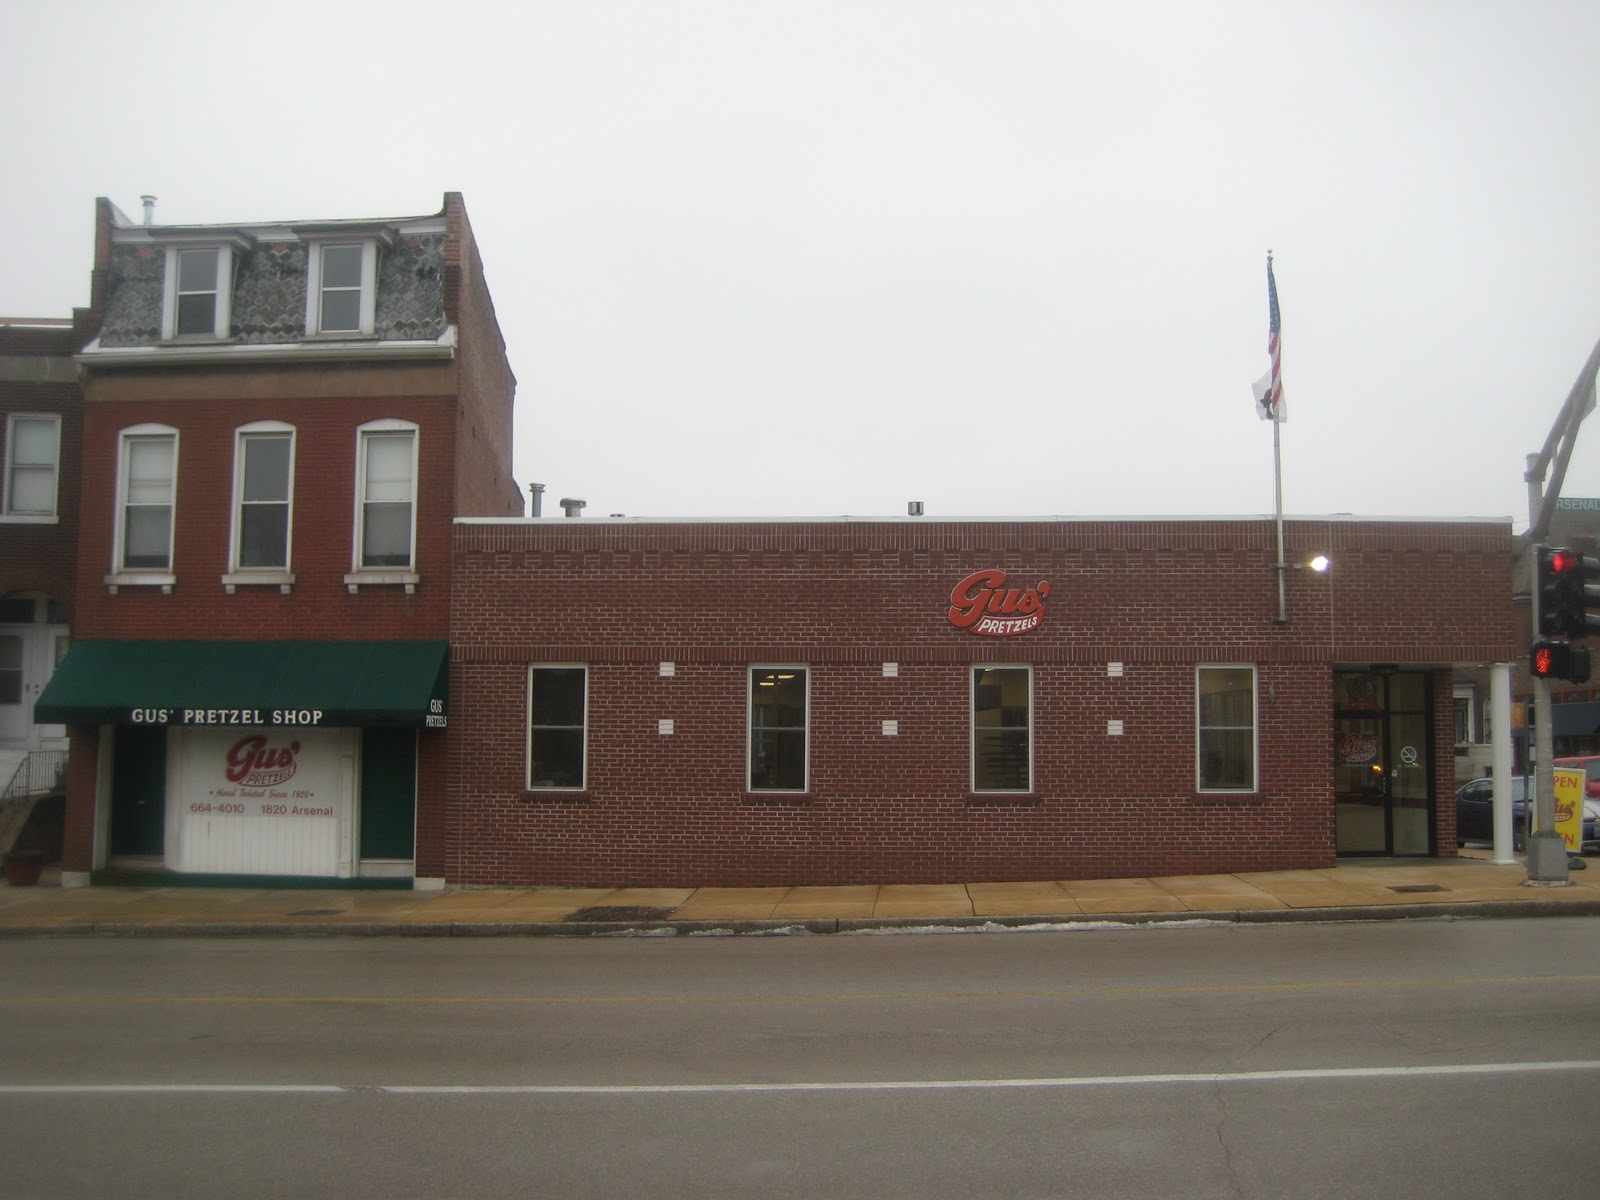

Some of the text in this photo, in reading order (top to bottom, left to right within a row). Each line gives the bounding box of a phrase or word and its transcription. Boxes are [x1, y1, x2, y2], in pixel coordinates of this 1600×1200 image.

[1554, 498, 1600, 510] RSENAL
[949, 568, 1050, 627] Gus'
[977, 616, 1037, 634] PRETZELS
[131, 708, 323, 725] GUS' PRETZEL SHOP
[425, 715, 448, 727] PRETZELS
[225, 734, 301, 782] Gus'
[246, 769, 292, 785] PRETZELS
[1553, 775, 1578, 788] PEN
[269, 789, 288, 799] Since
[292, 789, 310, 799] 1920
[190, 802, 333, 816] 664-4010 1820 Arsenal
